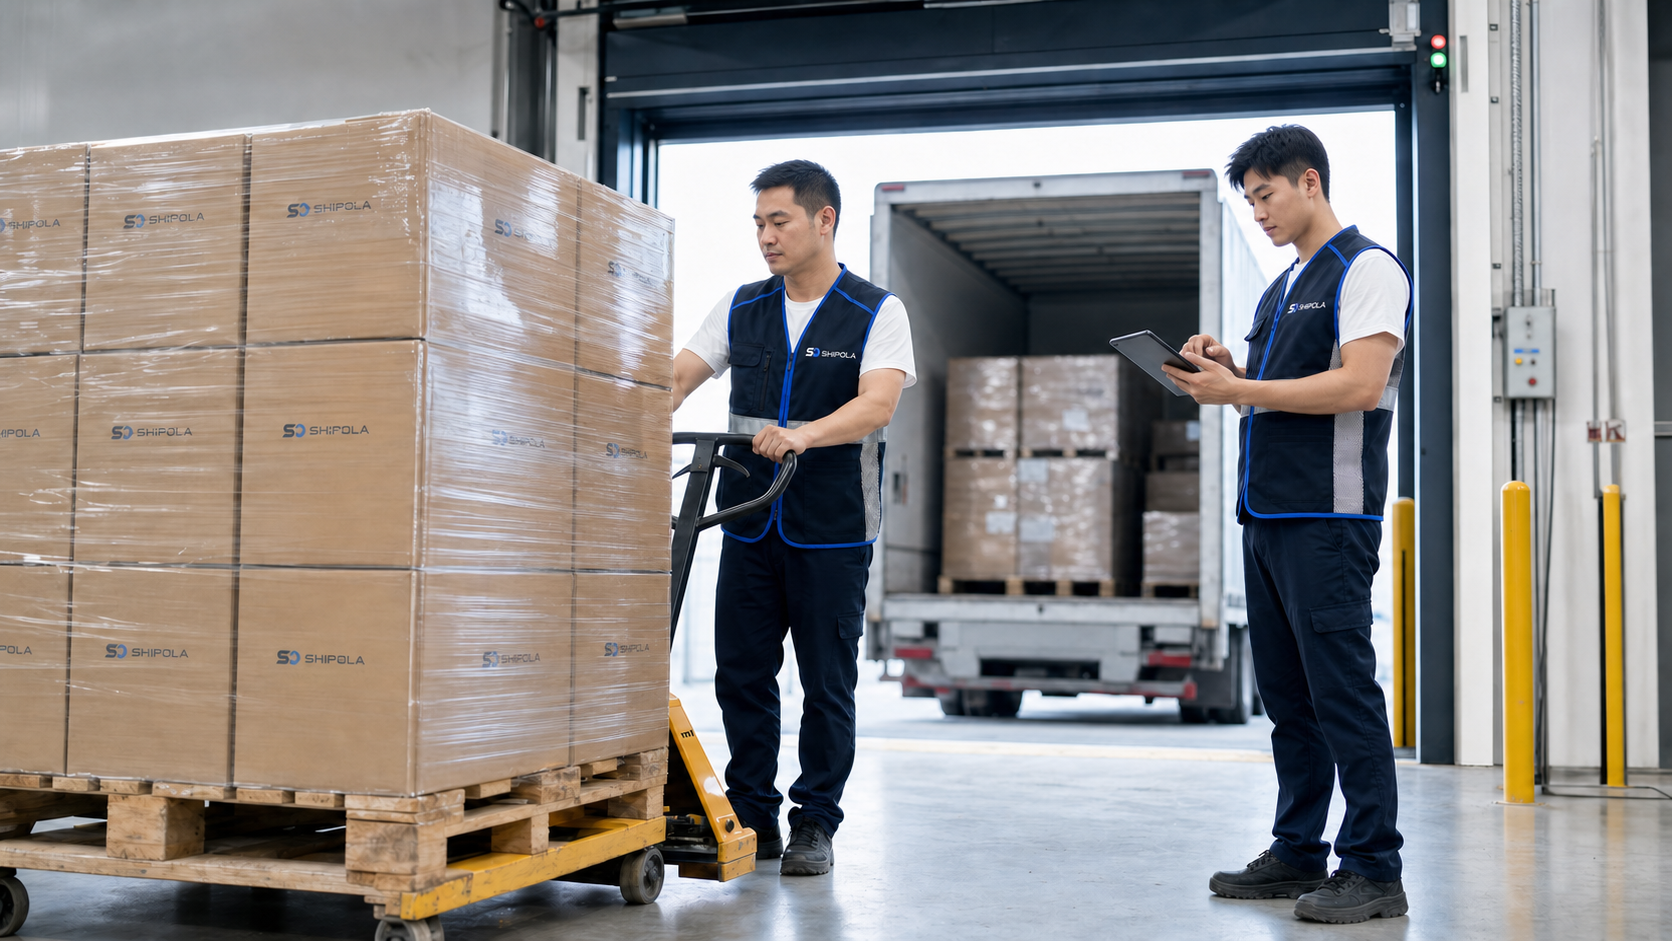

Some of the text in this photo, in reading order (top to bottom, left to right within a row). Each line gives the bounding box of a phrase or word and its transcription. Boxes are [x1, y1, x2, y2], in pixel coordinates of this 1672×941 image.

[313, 201, 372, 214] SHIPOLA
[148, 212, 205, 225] SHIPOLA
[821, 350, 857, 360] SHIPOLA
[136, 427, 193, 437] SHIPOLA
[309, 425, 370, 436] SHIPOLA
[131, 648, 189, 658] SHIPOLA
[304, 654, 366, 666] SHIPOLA
